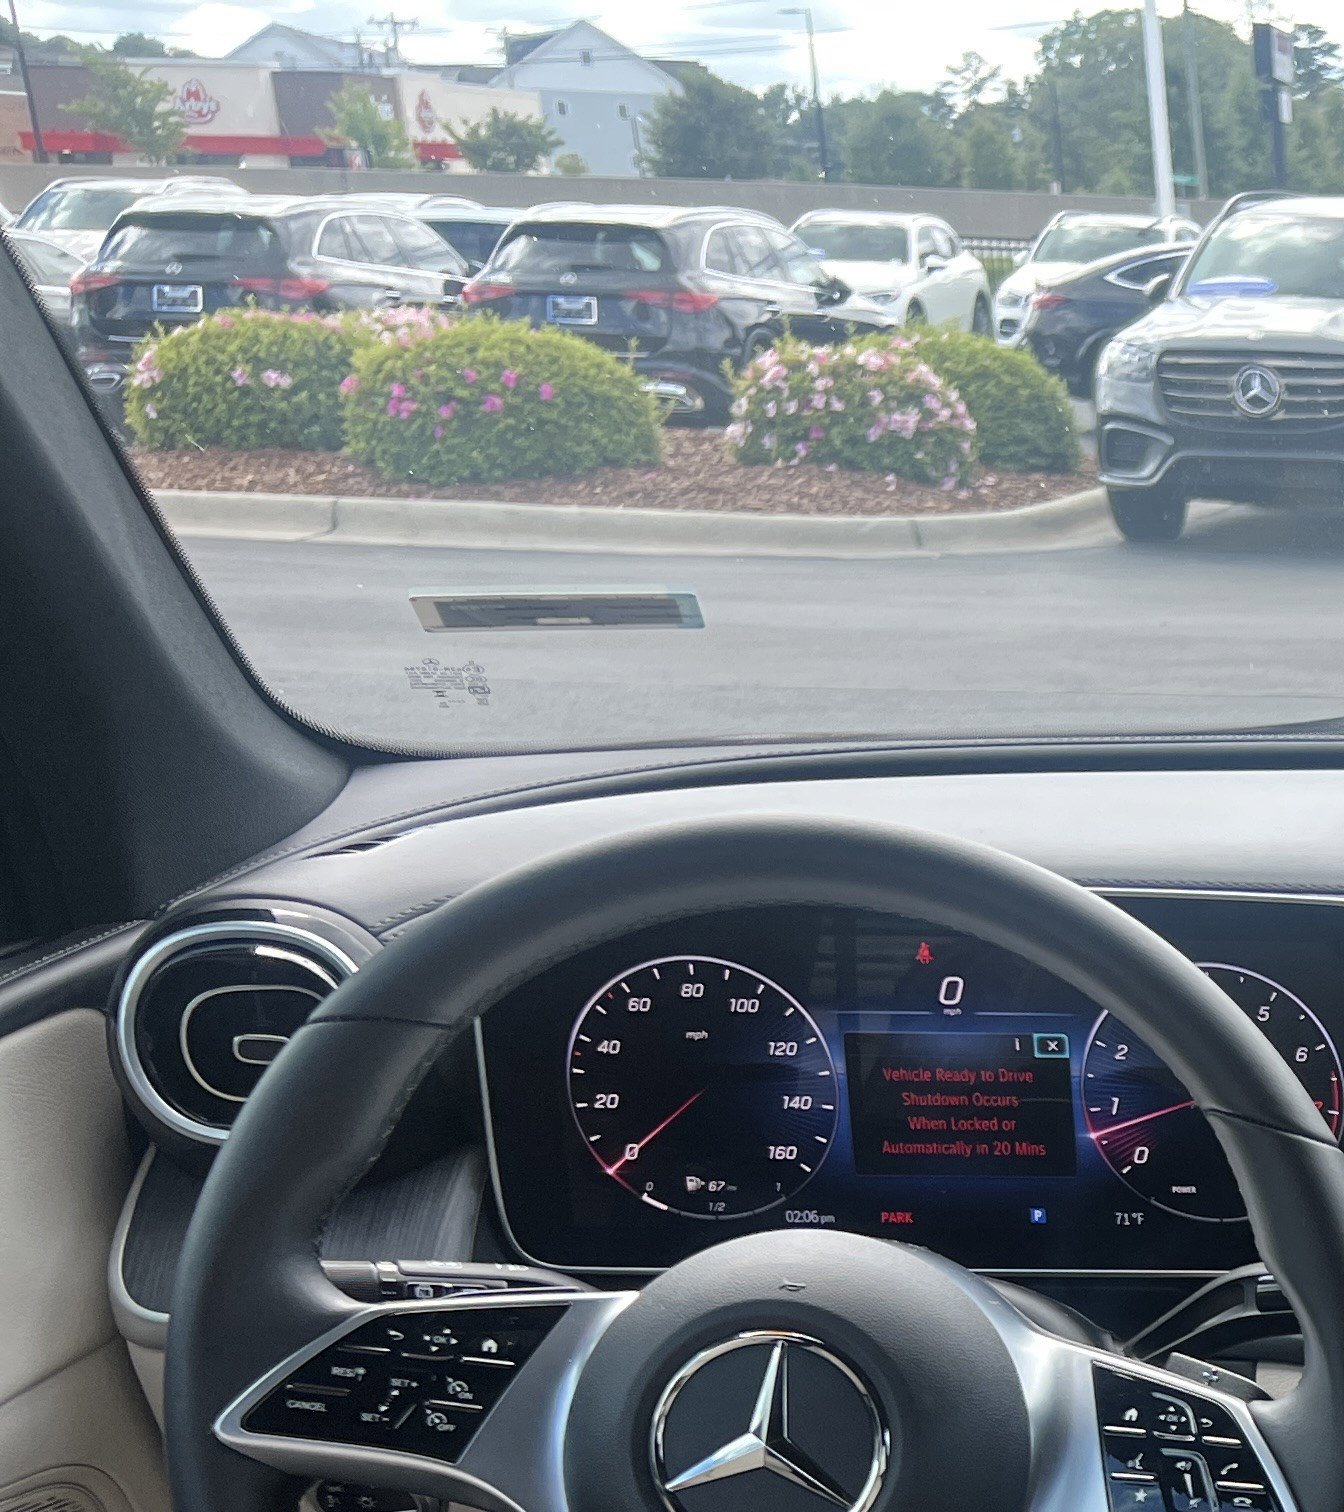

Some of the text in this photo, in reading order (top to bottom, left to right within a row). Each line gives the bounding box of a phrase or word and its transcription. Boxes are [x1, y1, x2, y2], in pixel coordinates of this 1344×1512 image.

[680, 983, 704, 998] 80
[938, 976, 965, 1006] 0
[627, 998, 651, 1012] 60
[729, 999, 759, 1013] 100
[1257, 1006, 1271, 1022] 5
[685, 1030, 709, 1042] mph
[597, 1040, 621, 1054] 40
[768, 1042, 798, 1056] 120
[1114, 1044, 1129, 1060] 2
[1295, 1046, 1309, 1062] 6
[882, 1067, 1034, 1085] Vehicle Ready to Drive
[594, 1093, 620, 1109] 20
[782, 1095, 813, 1110] 140
[901, 1092, 1020, 1108] Shutdown Occurs
[1111, 1097, 1120, 1115] 1
[907, 1116, 1017, 1131] When Locked or
[625, 1143, 641, 1161] 0
[768, 1145, 798, 1160] 160
[881, 1141, 1047, 1157] Automatically in 20 Mins
[1134, 1146, 1149, 1164] 0
[707, 1181, 726, 1192] 67
[708, 1202, 726, 1213] 1/2
[881, 1212, 913, 1224] PARK
[1115, 1212, 1145, 1225] 71°F
